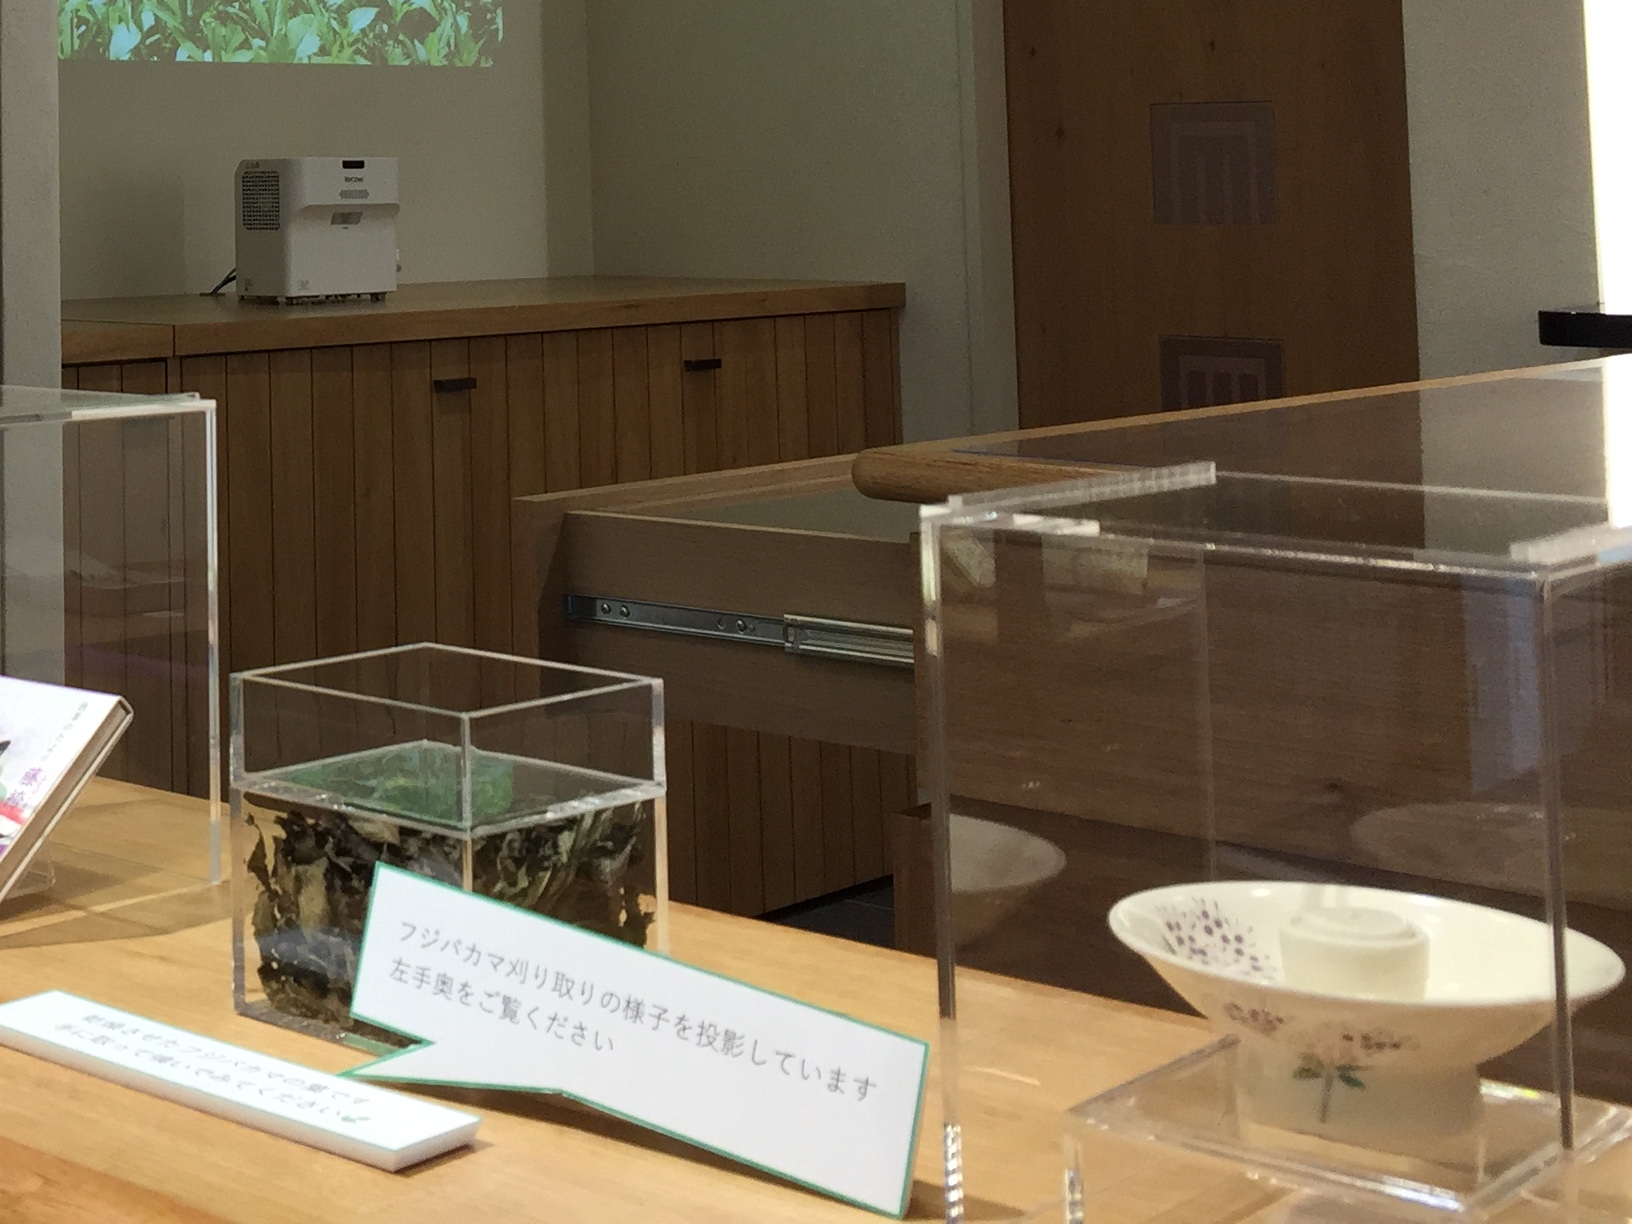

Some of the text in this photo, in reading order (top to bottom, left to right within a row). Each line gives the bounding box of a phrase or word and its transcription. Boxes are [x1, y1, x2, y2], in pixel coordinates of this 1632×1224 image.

[389, 957, 616, 1054] 左手奥をご覧ください
[399, 921, 879, 1103] フジバカマ刈り取りの様子を投影しています
